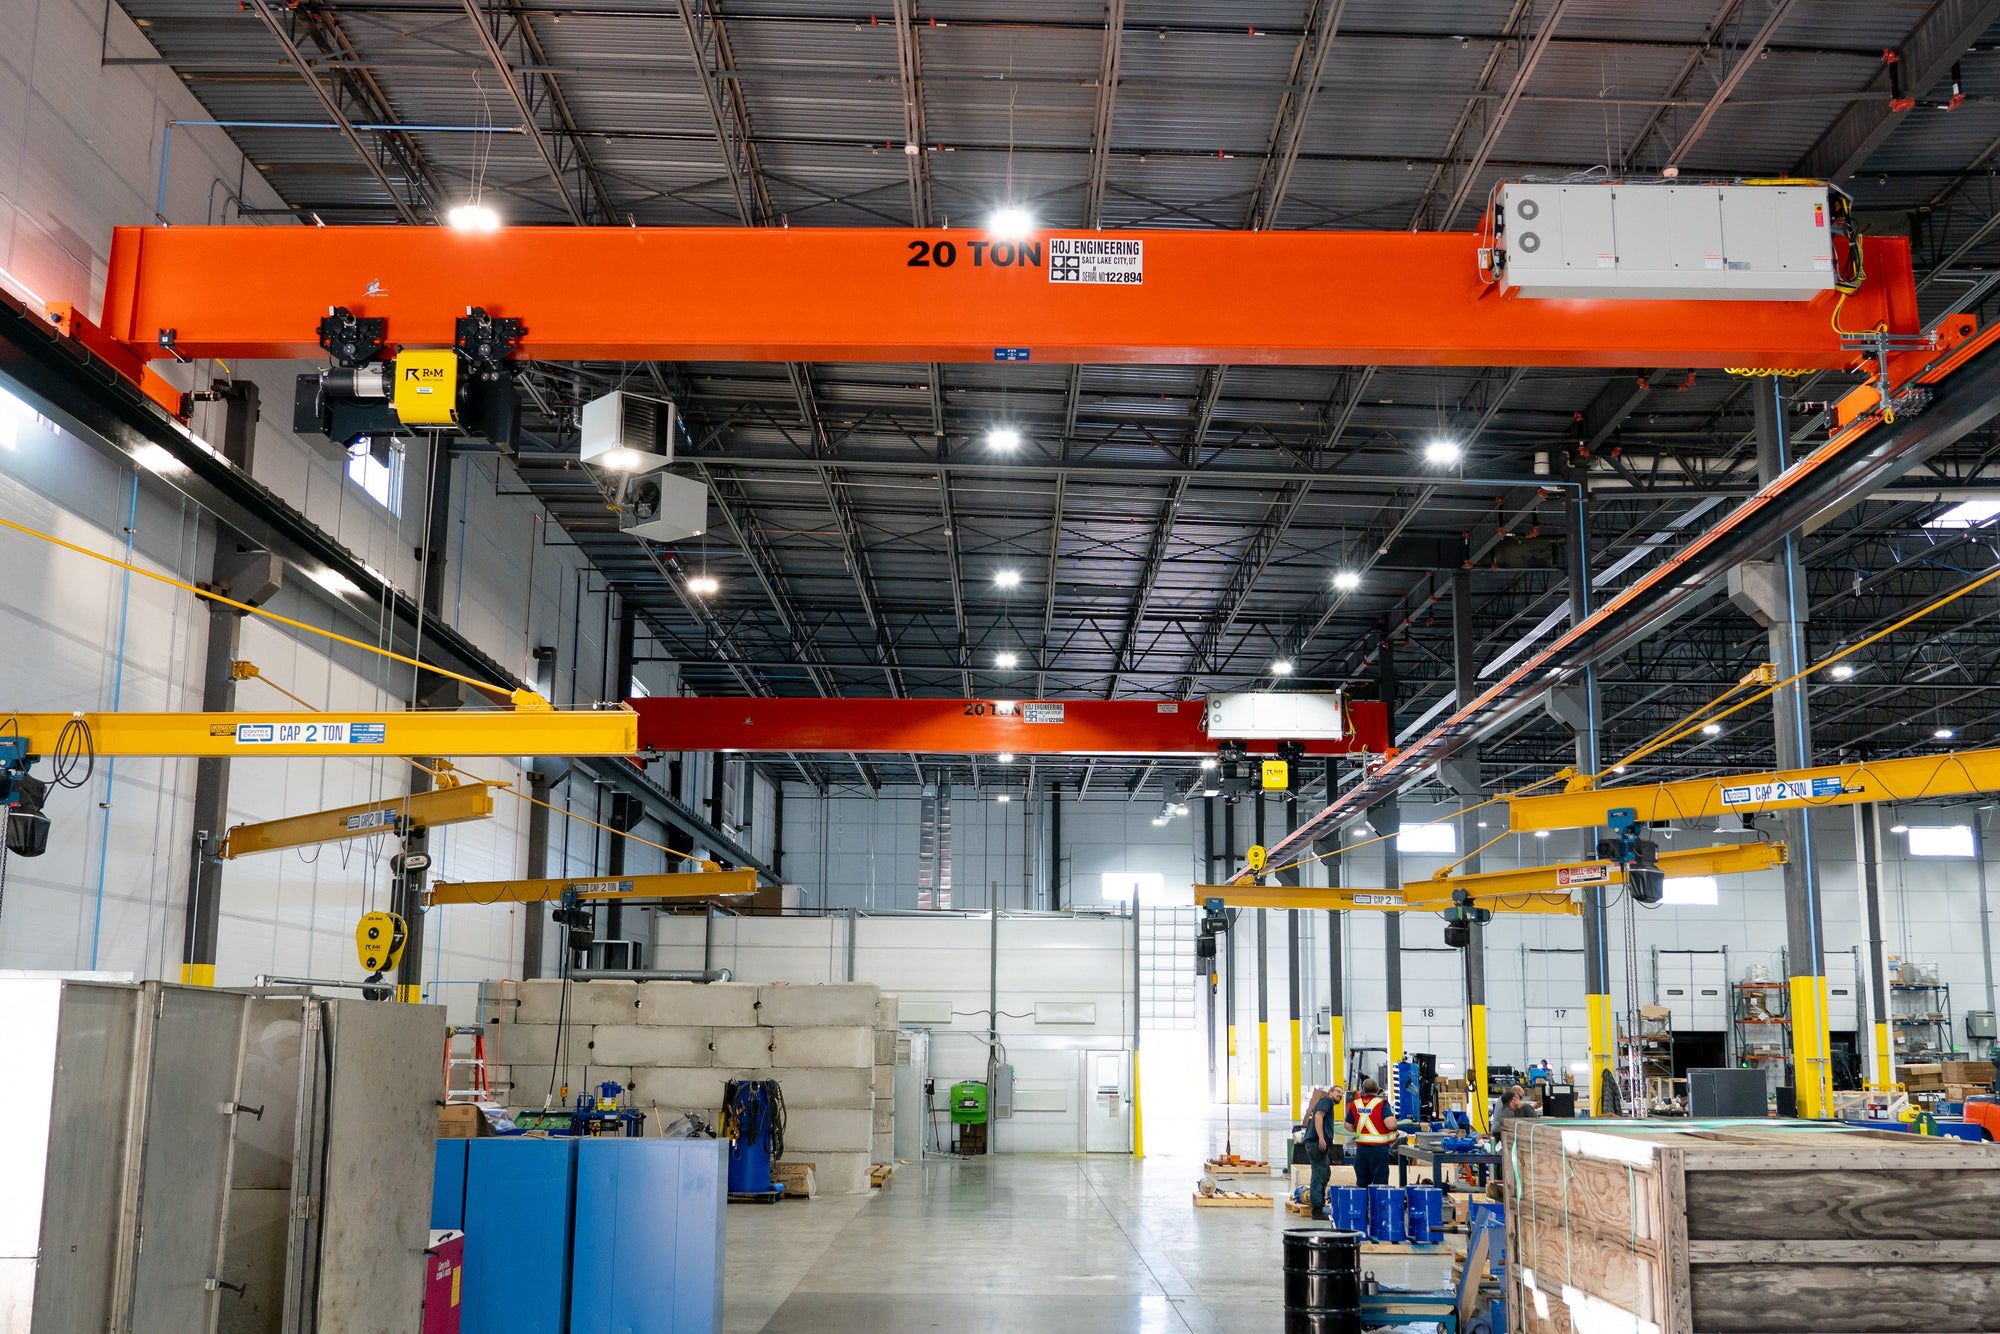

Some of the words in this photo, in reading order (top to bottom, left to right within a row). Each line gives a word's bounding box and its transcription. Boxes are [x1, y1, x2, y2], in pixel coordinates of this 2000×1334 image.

[1052, 240, 1070, 254] HOJ
[1075, 241, 1140, 256] ENGINEERING
[908, 240, 957, 267] 20
[967, 241, 1041, 267] TON
[1082, 256, 1095, 265] SALT
[1098, 257, 1112, 265] LAKE
[964, 704, 984, 716] 20
[990, 704, 1020, 716] TN
[306, 724, 317, 742] 2
[322, 725, 343, 740] TON
[1777, 784, 1786, 799] 2
[1790, 782, 1806, 796] TON
[601, 884, 606, 892] 2
[1386, 896, 1391, 904] 2
[1422, 1009, 1434, 1017] 18
[1555, 1010, 1566, 1018] 17
